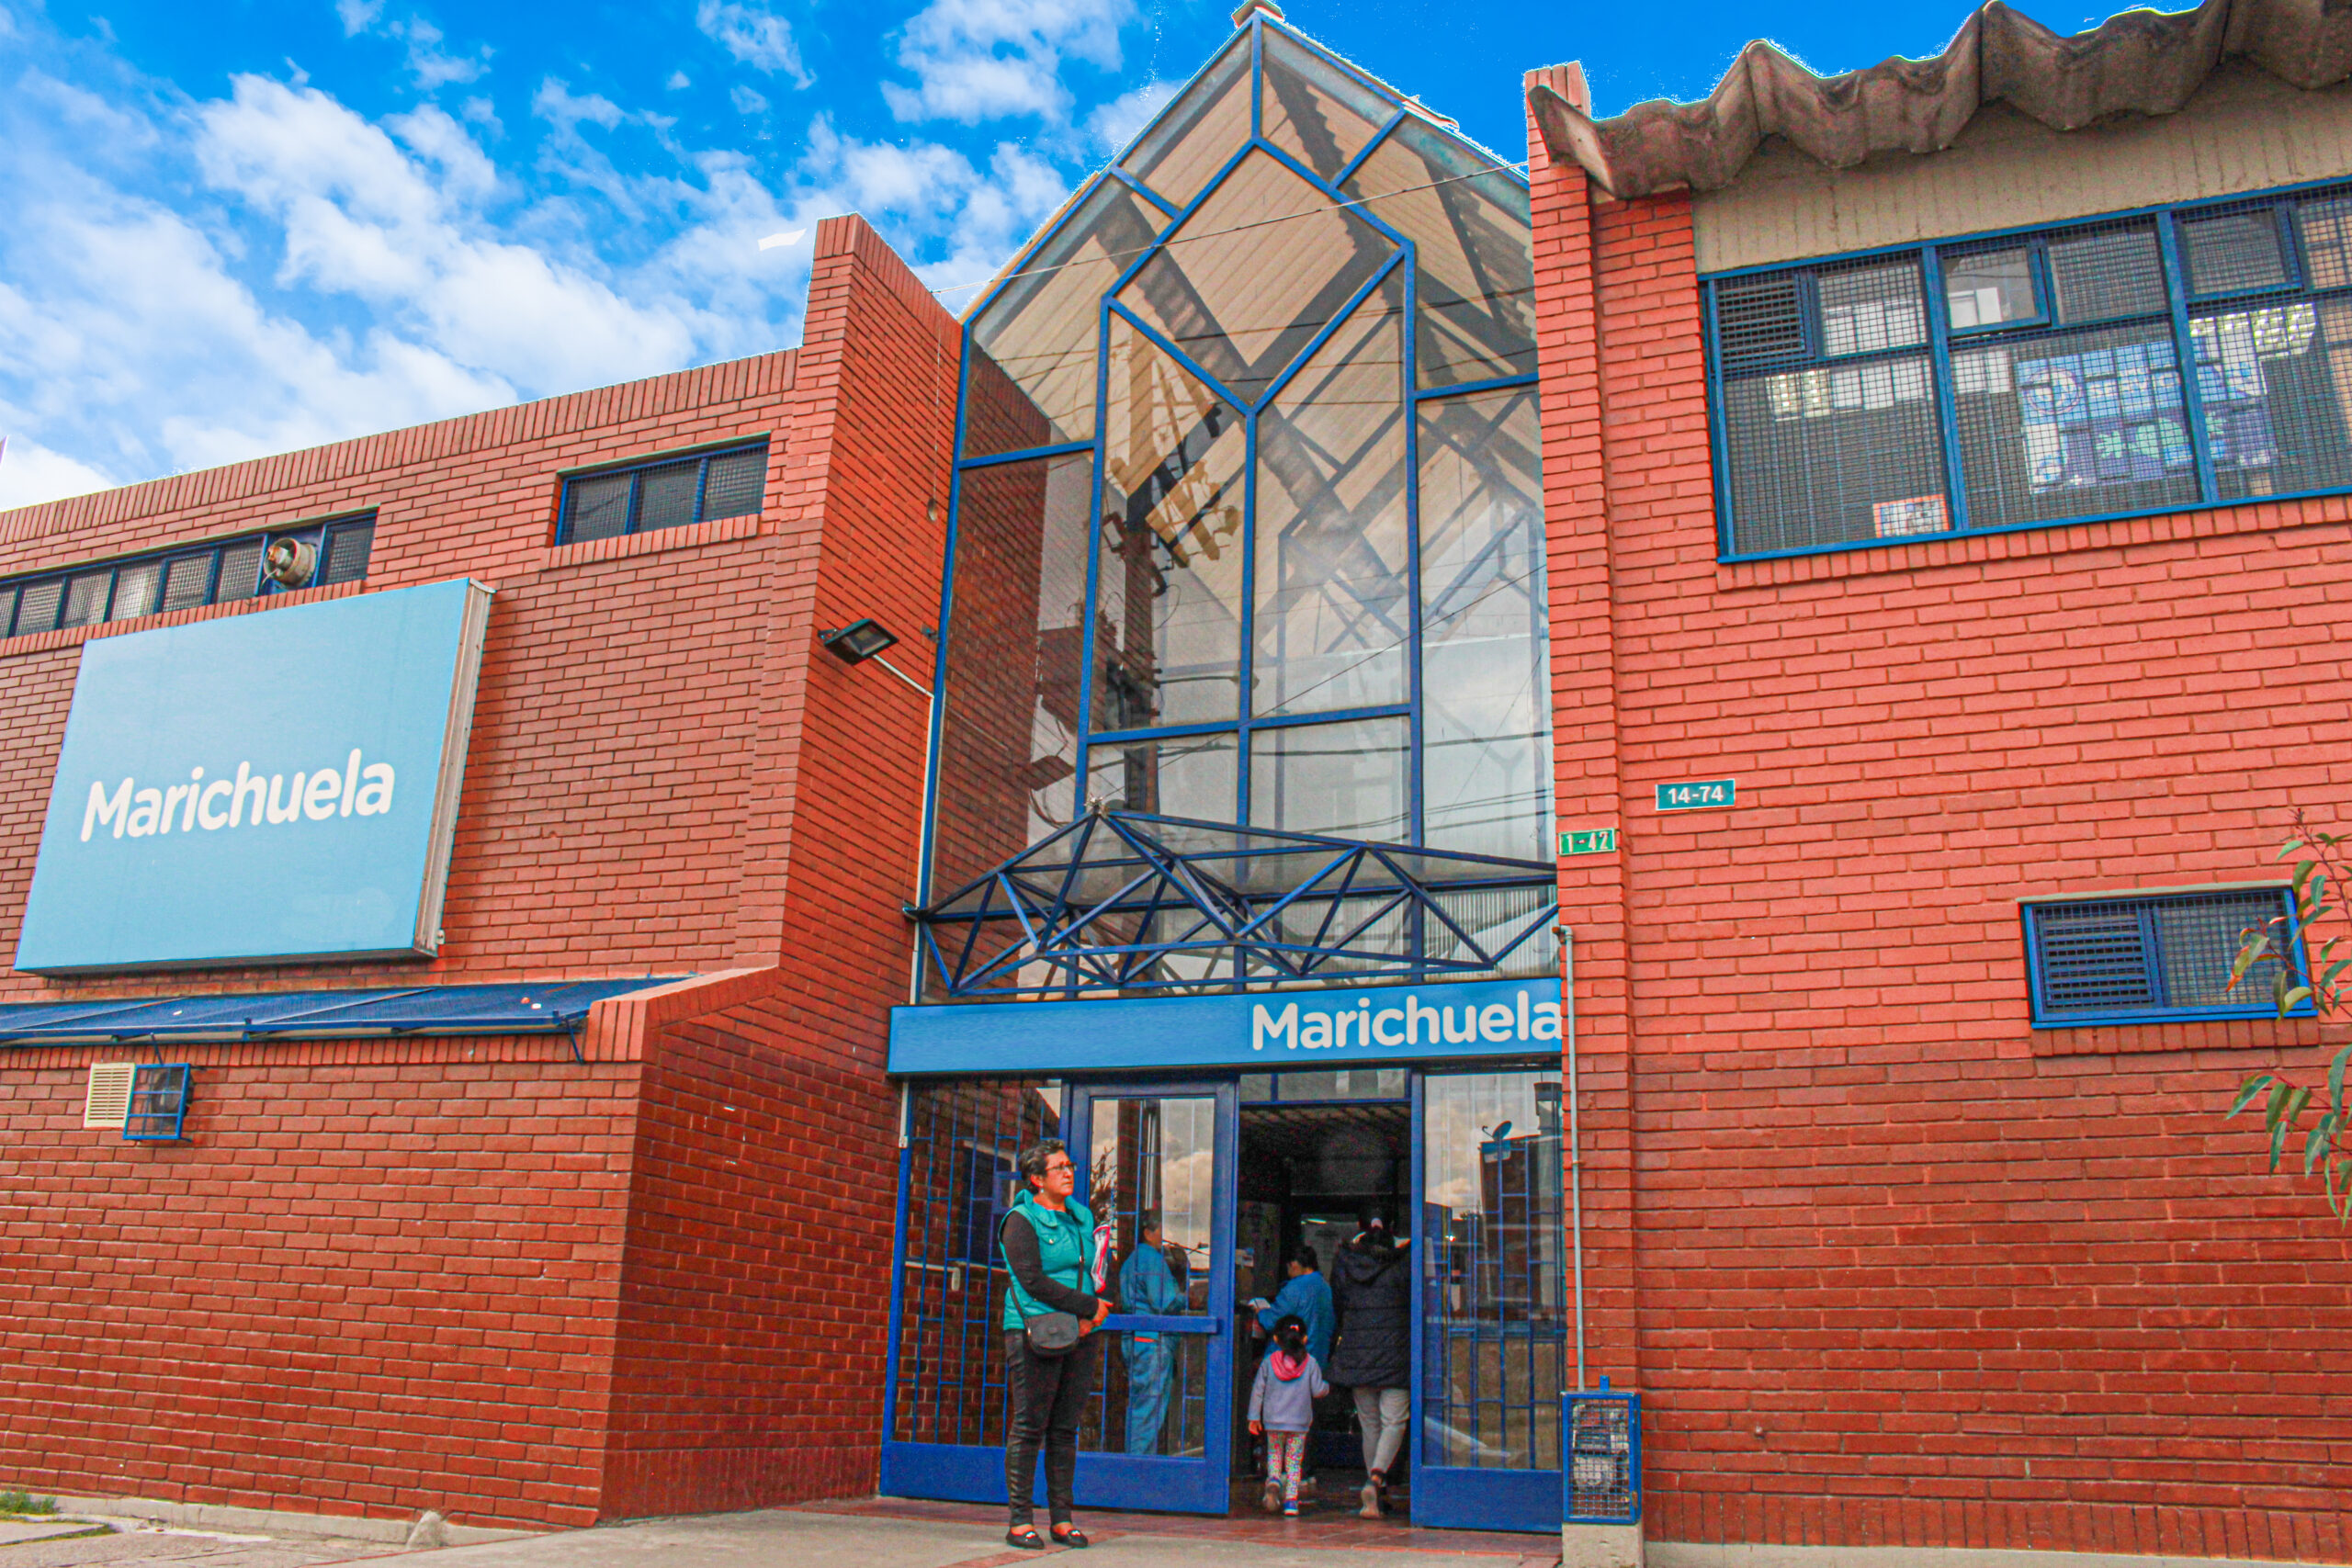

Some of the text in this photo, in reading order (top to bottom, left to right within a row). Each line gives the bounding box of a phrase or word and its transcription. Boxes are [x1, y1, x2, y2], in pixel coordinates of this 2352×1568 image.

[80, 748, 395, 842] Marichuela
[1668, 785, 1724, 805] 14-74
[1566, 831, 1609, 852] 1-42
[1252, 989, 1562, 1051] Marichuela
